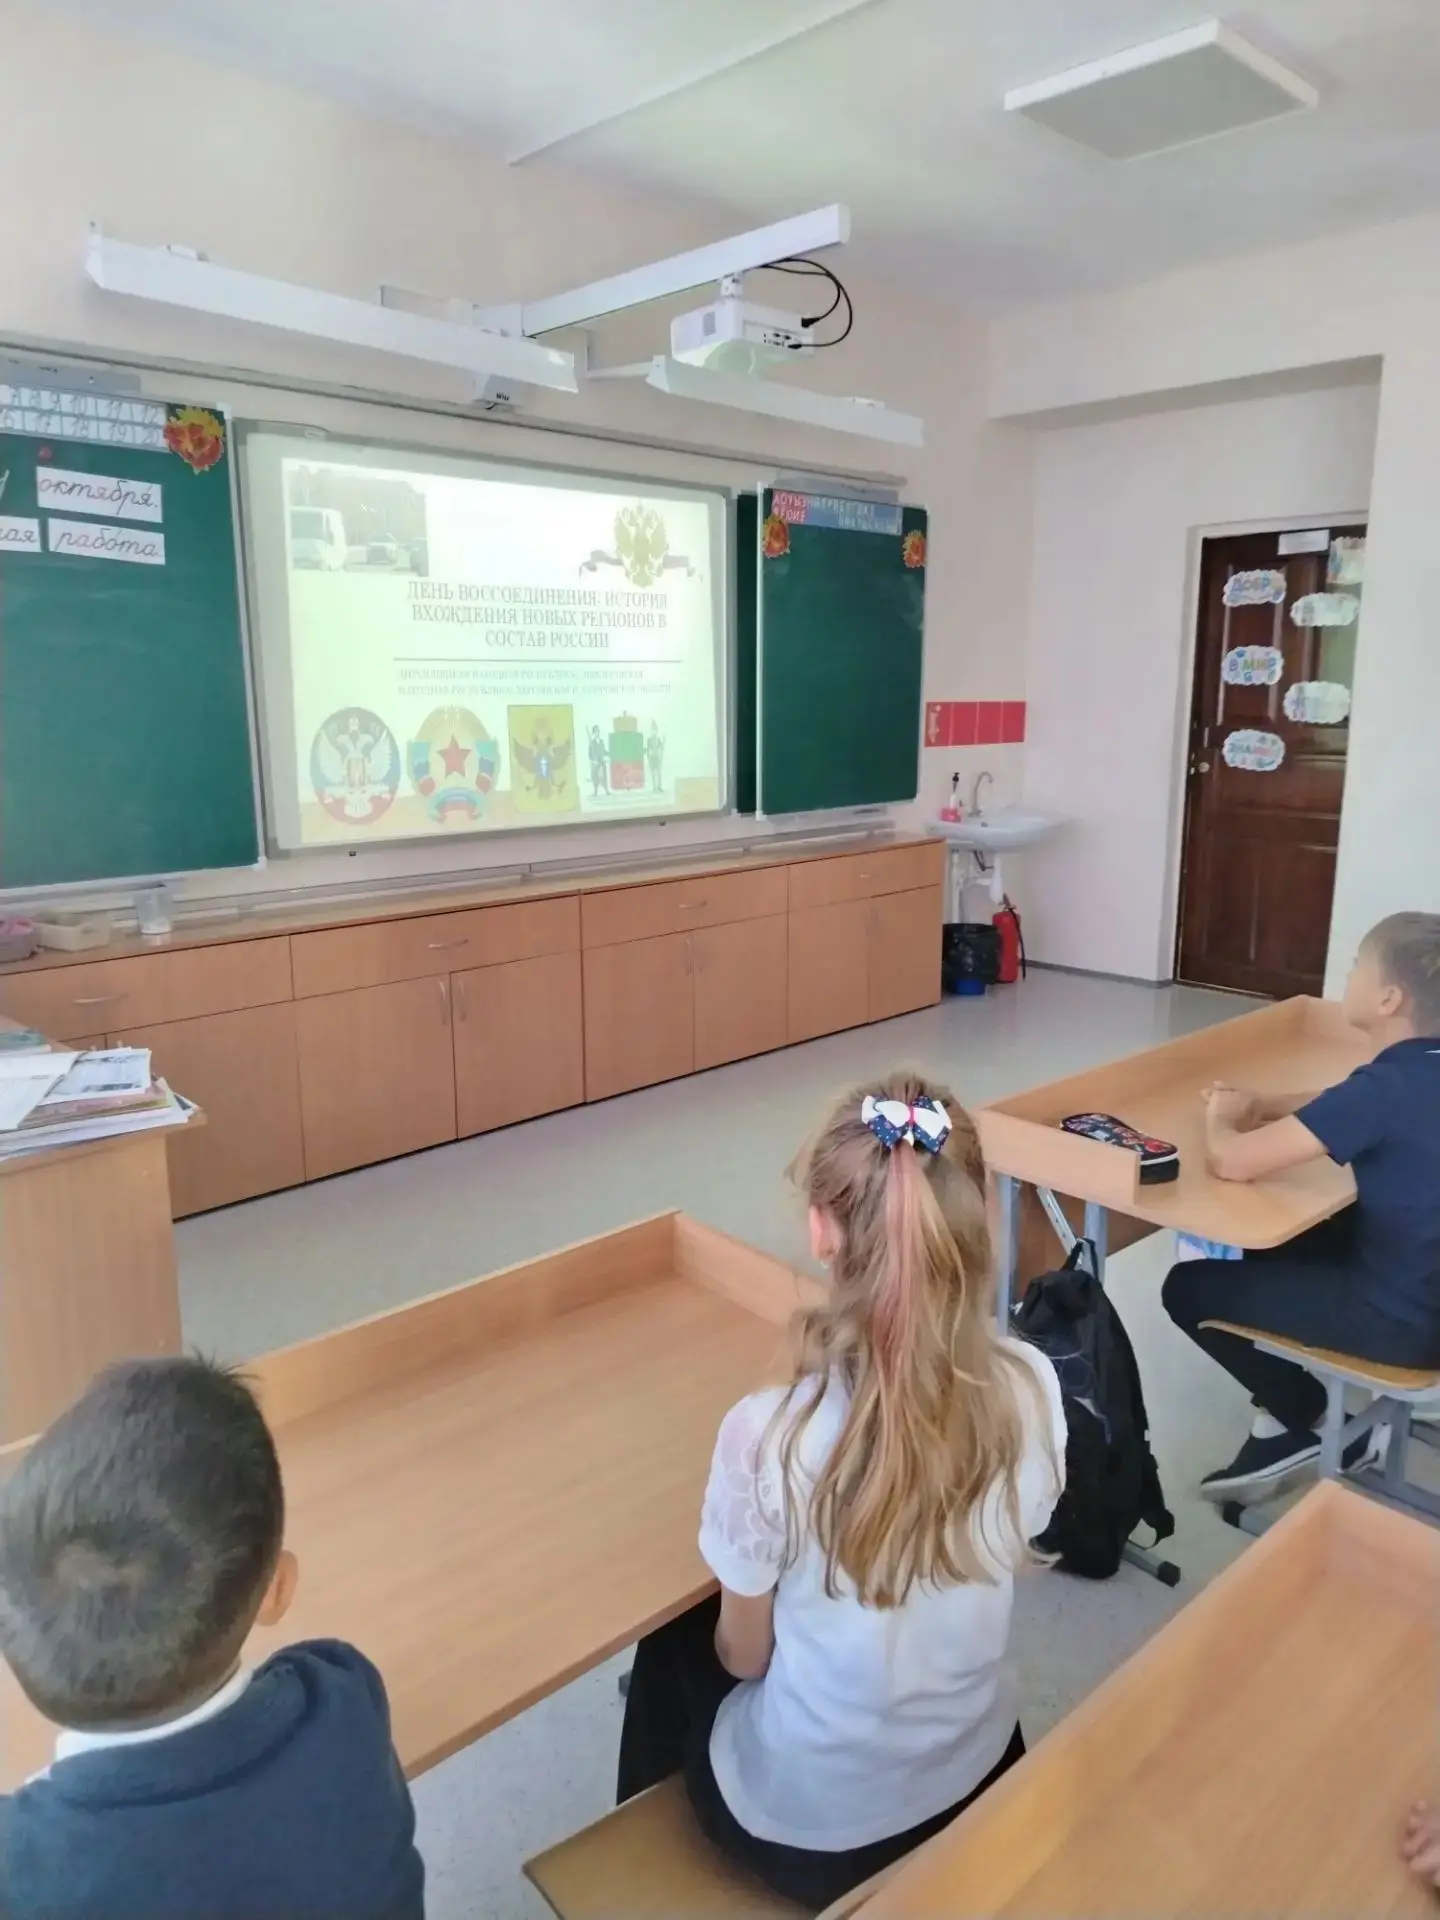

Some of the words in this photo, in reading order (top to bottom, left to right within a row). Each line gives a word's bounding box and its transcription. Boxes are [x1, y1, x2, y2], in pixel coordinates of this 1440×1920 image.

[0, 528, 36, 543] ая
[407, 581, 453, 600] ДЕНЬ
[605, 591, 667, 609] ИСТОРИЯ
[412, 604, 518, 626] ВХОЖДЕНИЯ
[522, 608, 576, 626] НОВЫХ
[581, 610, 655, 628] РЕГИОНОВ
[658, 613, 667, 628] В
[485, 630, 546, 648] СОСТАВ
[550, 632, 609, 648] РОССИИ
